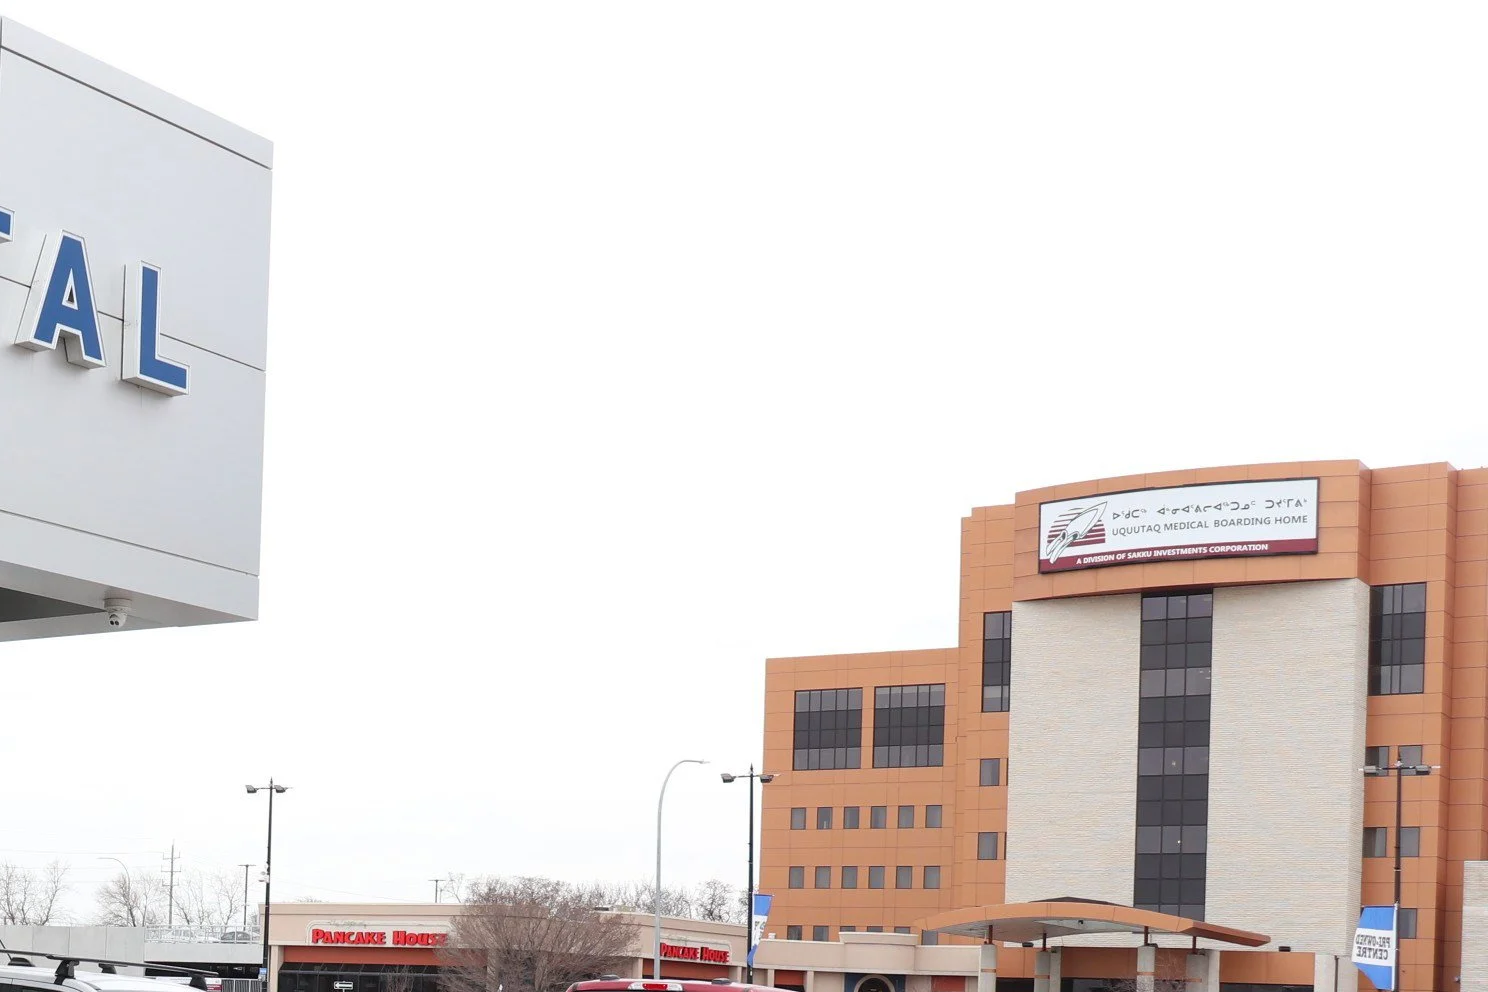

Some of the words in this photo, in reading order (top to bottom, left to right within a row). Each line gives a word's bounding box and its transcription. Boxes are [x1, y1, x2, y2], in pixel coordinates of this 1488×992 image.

[1112, 524, 1161, 536] UQUUTAQ
[1164, 521, 1209, 531] MEDICAL
[1214, 517, 1271, 528] BOARDING
[1275, 515, 1308, 525] HOME
[1083, 555, 1115, 564] DIVISION
[1127, 551, 1152, 559] SAKKU
[1153, 546, 1208, 557] INVESTMENTS
[1209, 544, 1268, 553] CORPORATION
[312, 928, 386, 945] PANCAKE
[660, 942, 700, 960] PANCAKE
[700, 946, 730, 963] HOUSE
